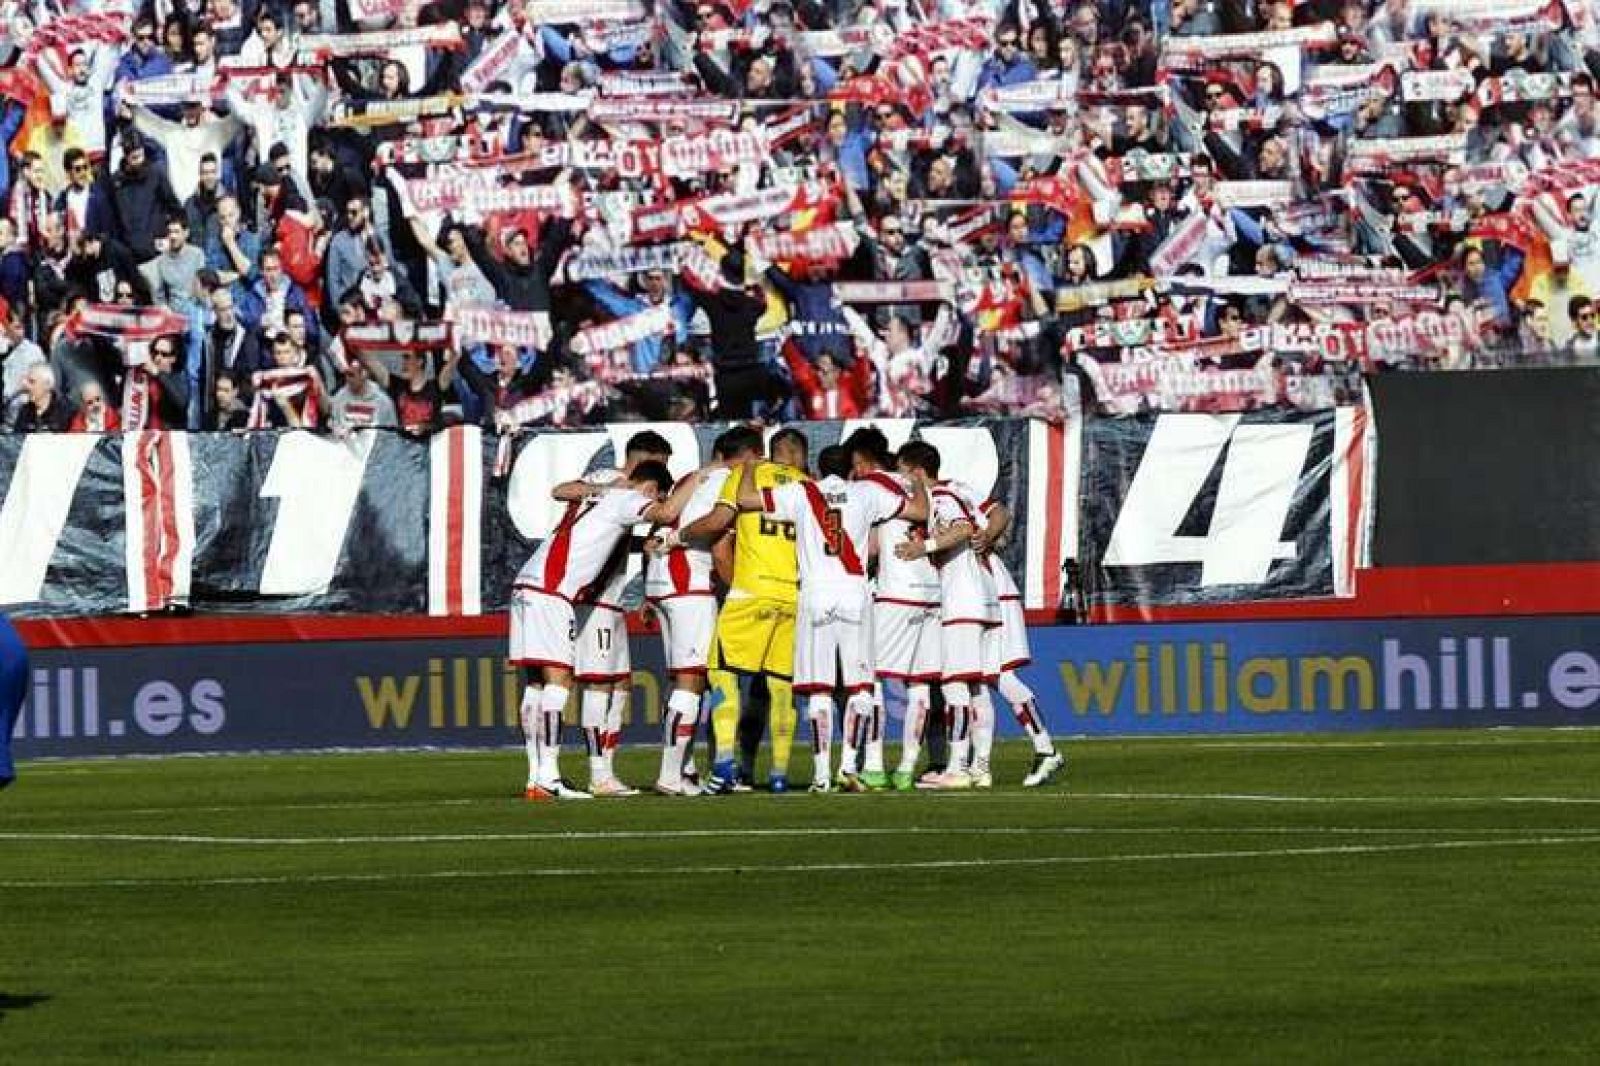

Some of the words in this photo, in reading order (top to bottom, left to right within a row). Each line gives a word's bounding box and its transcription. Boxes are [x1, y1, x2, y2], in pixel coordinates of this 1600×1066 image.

[1101, 413, 1315, 587] 4
[597, 628, 611, 651] 17
[13, 667, 226, 738] ill.es
